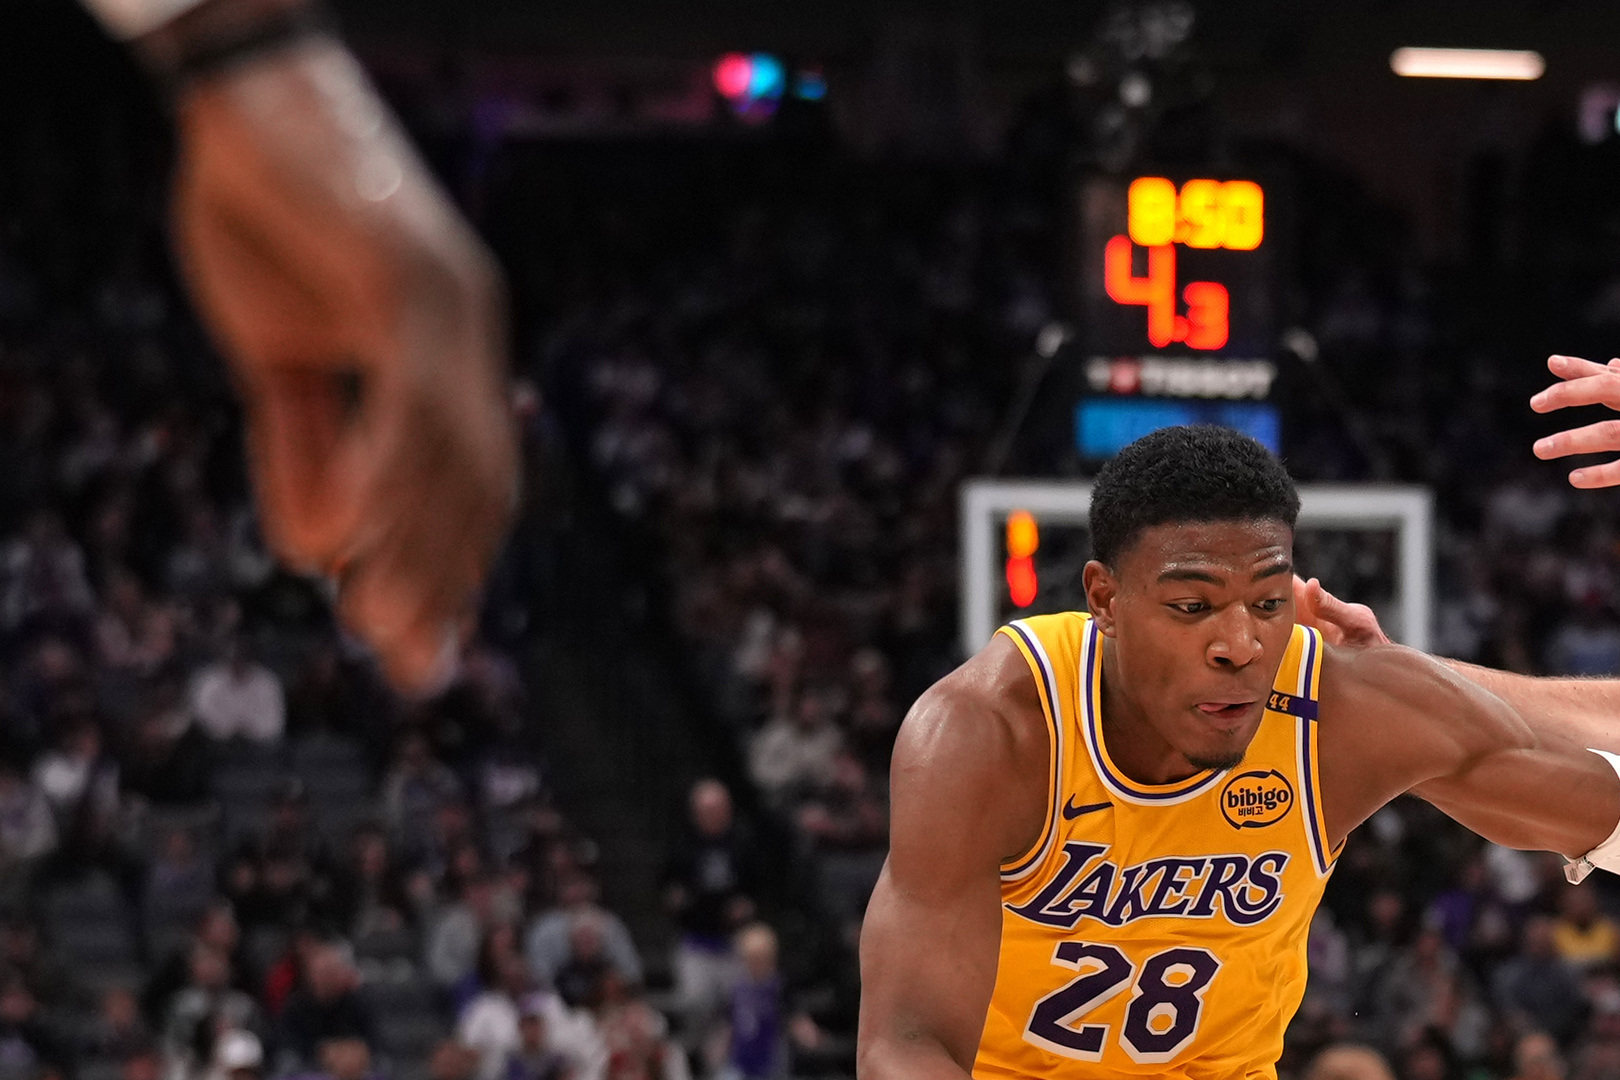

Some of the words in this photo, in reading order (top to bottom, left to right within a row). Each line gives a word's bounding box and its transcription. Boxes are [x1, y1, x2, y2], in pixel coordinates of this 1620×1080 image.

[1269, 693, 1291, 711] 44
[1227, 785, 1289, 810] bibigo
[1238, 806, 1263, 817] 비비고
[1002, 840, 1292, 929] LAKERS
[1022, 941, 1223, 1064] 28
